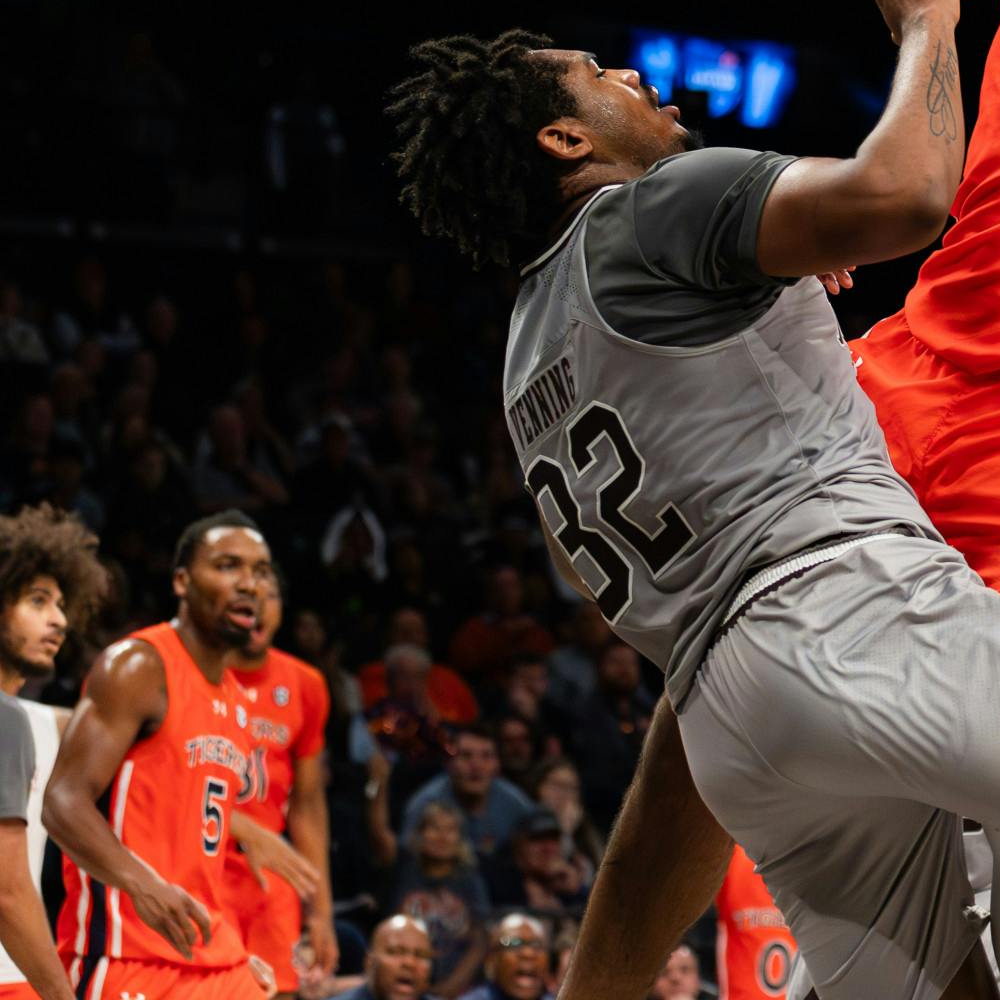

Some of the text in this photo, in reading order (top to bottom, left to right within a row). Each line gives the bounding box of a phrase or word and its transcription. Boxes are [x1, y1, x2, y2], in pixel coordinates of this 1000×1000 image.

[508, 357, 576, 450] VENNING
[524, 400, 698, 627] 32
[202, 776, 228, 857] 5
